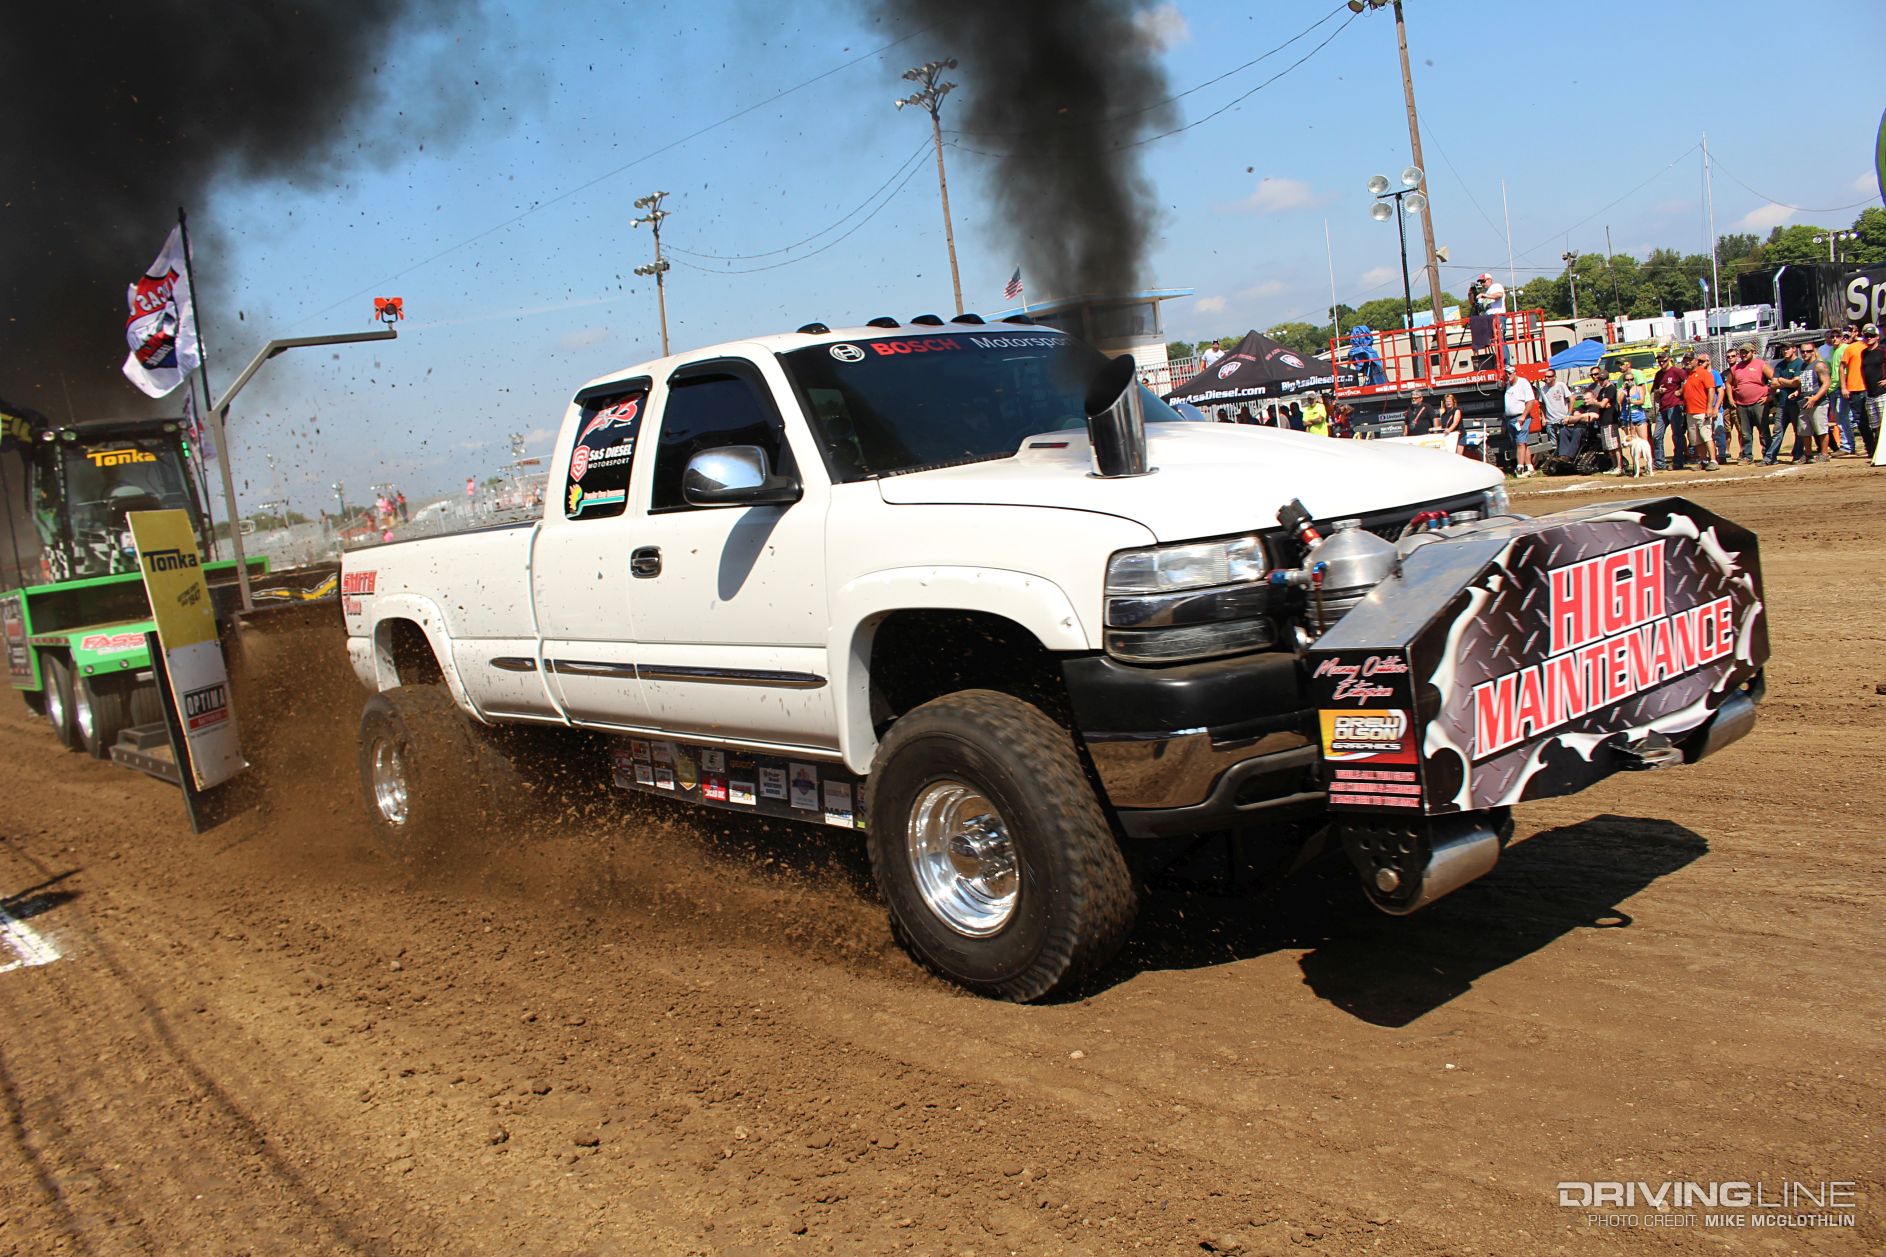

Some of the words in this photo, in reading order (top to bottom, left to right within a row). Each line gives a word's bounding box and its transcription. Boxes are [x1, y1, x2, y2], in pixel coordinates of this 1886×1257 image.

[870, 338, 961, 356] BOSCH
[969, 336, 1072, 349] Motorspor
[1281, 374, 1354, 392] BigAssDieselco
[87, 448, 157, 468] Tonka
[588, 448, 605, 462] S&S
[605, 444, 632, 459] DIESEL
[588, 457, 630, 470] MOTORSPORT
[142, 548, 198, 573] Tonka
[1547, 538, 1667, 658] HIGH
[1471, 595, 1734, 761] MAINTENANCE
[186, 686, 225, 716] OPTIMA
[1335, 716, 1400, 729] DREW
[1334, 727, 1399, 741] OLSON
